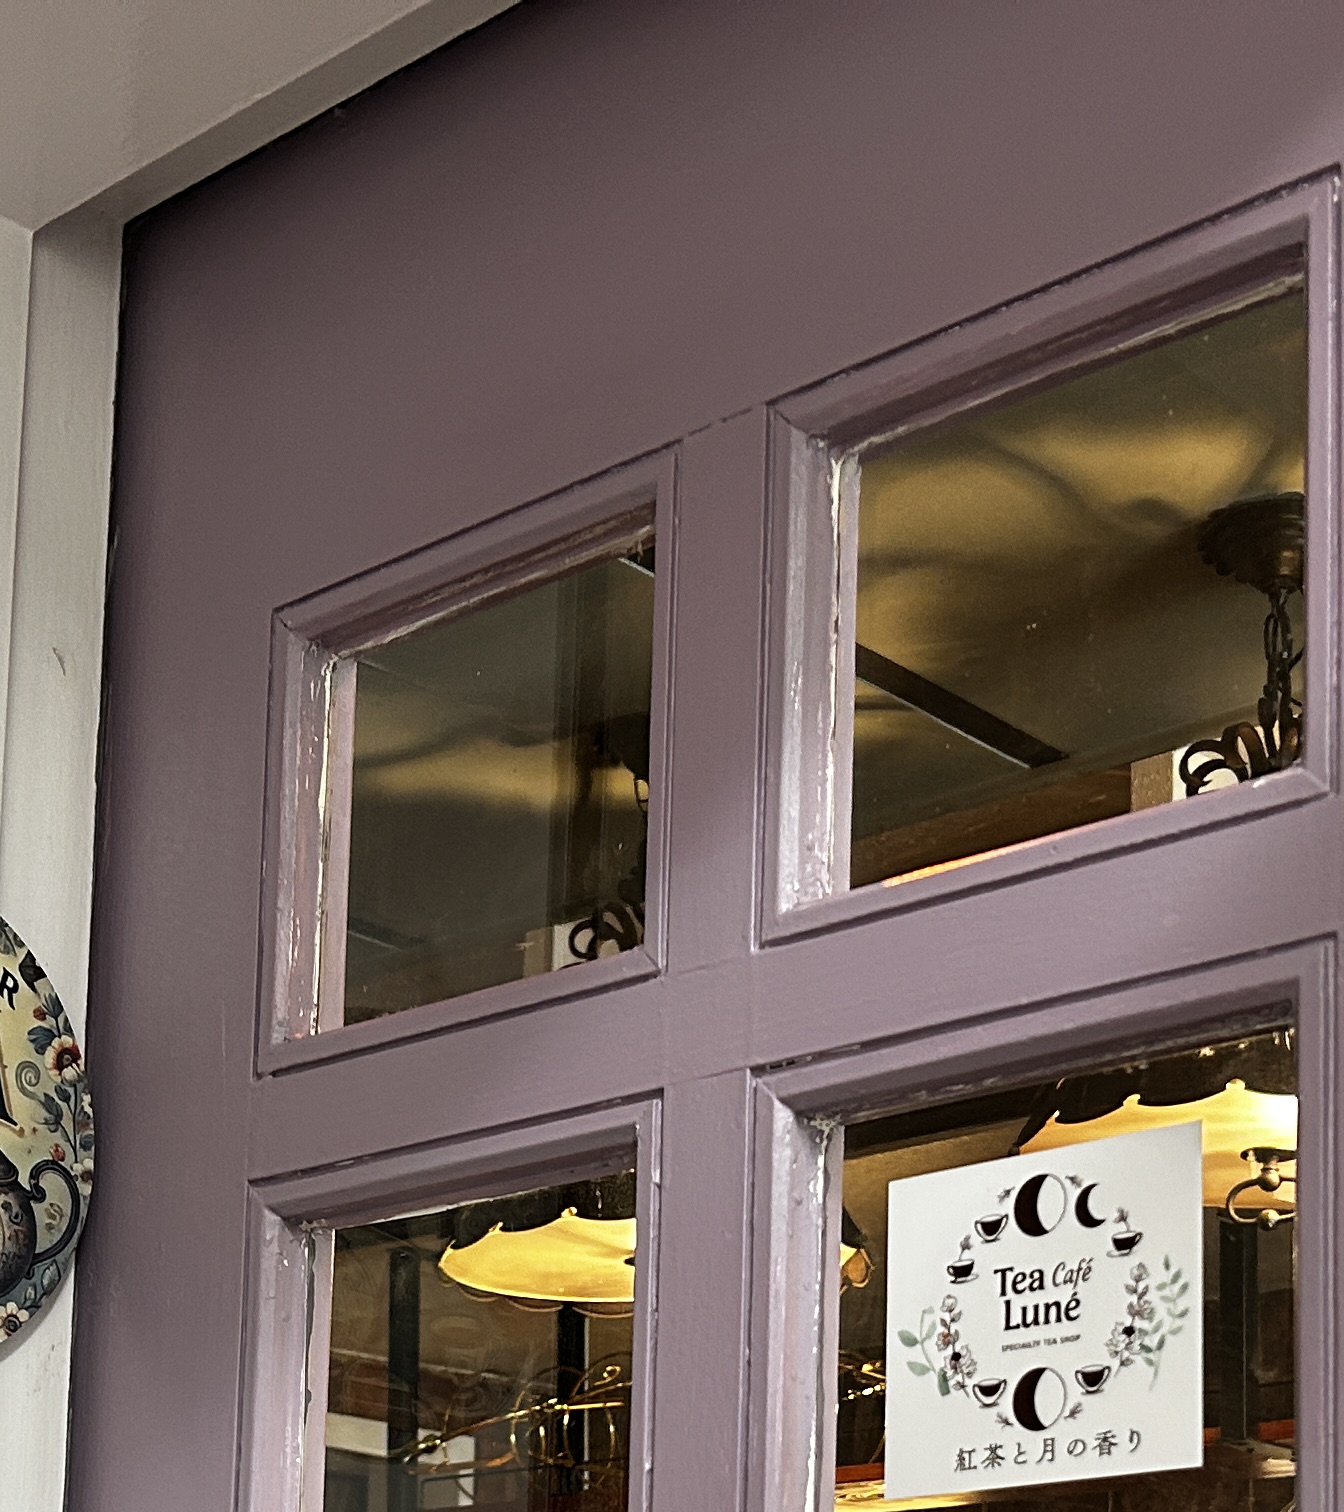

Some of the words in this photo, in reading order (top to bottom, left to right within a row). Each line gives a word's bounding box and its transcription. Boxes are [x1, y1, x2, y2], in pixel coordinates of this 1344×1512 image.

[993, 1266, 1045, 1297] Tea
[1051, 1257, 1094, 1290] Café
[1003, 1291, 1081, 1332] Luné
[954, 1428, 1143, 1473] 紅茶と月の香り
